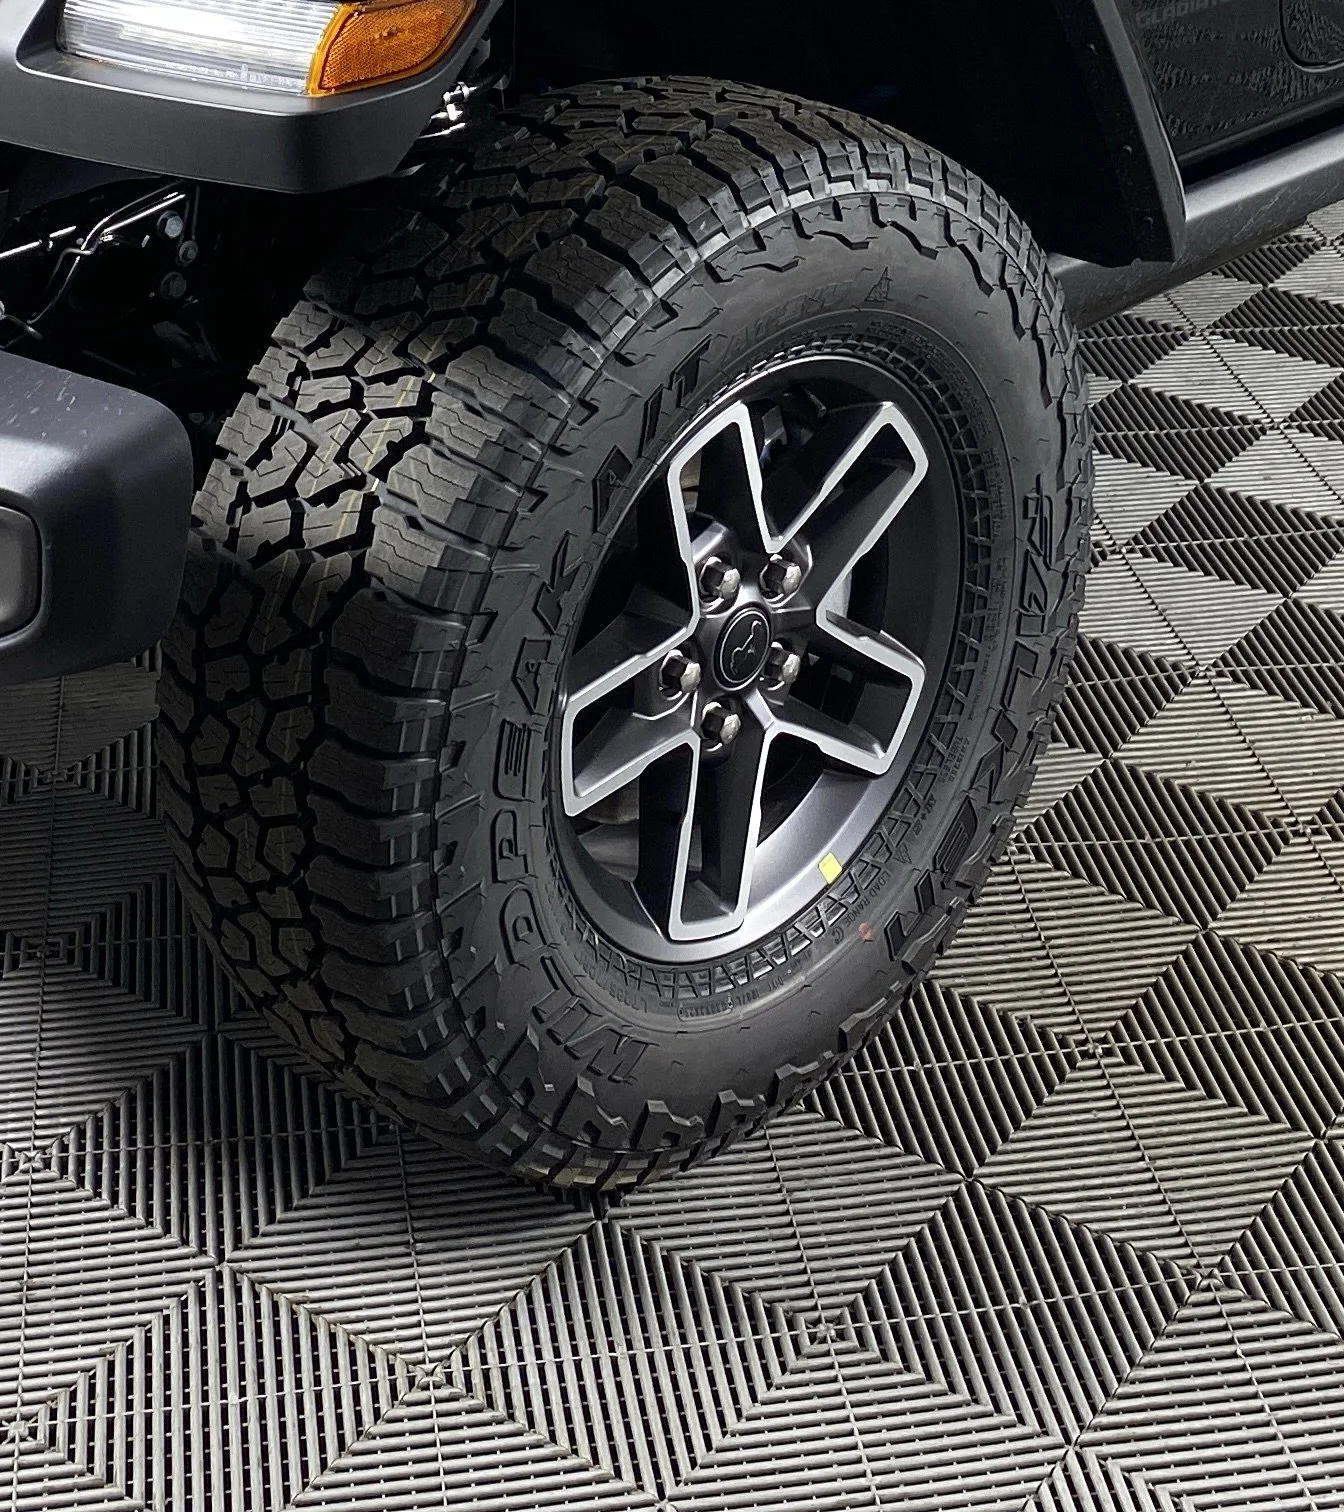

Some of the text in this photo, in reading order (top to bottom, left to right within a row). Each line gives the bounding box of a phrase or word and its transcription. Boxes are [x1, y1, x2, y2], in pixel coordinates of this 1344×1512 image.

[492, 531, 653, 1082] WILDPEAK
[884, 474, 1052, 962] FALKEN
[844, 896, 871, 929] RANGE
[867, 869, 892, 899] LOAD
